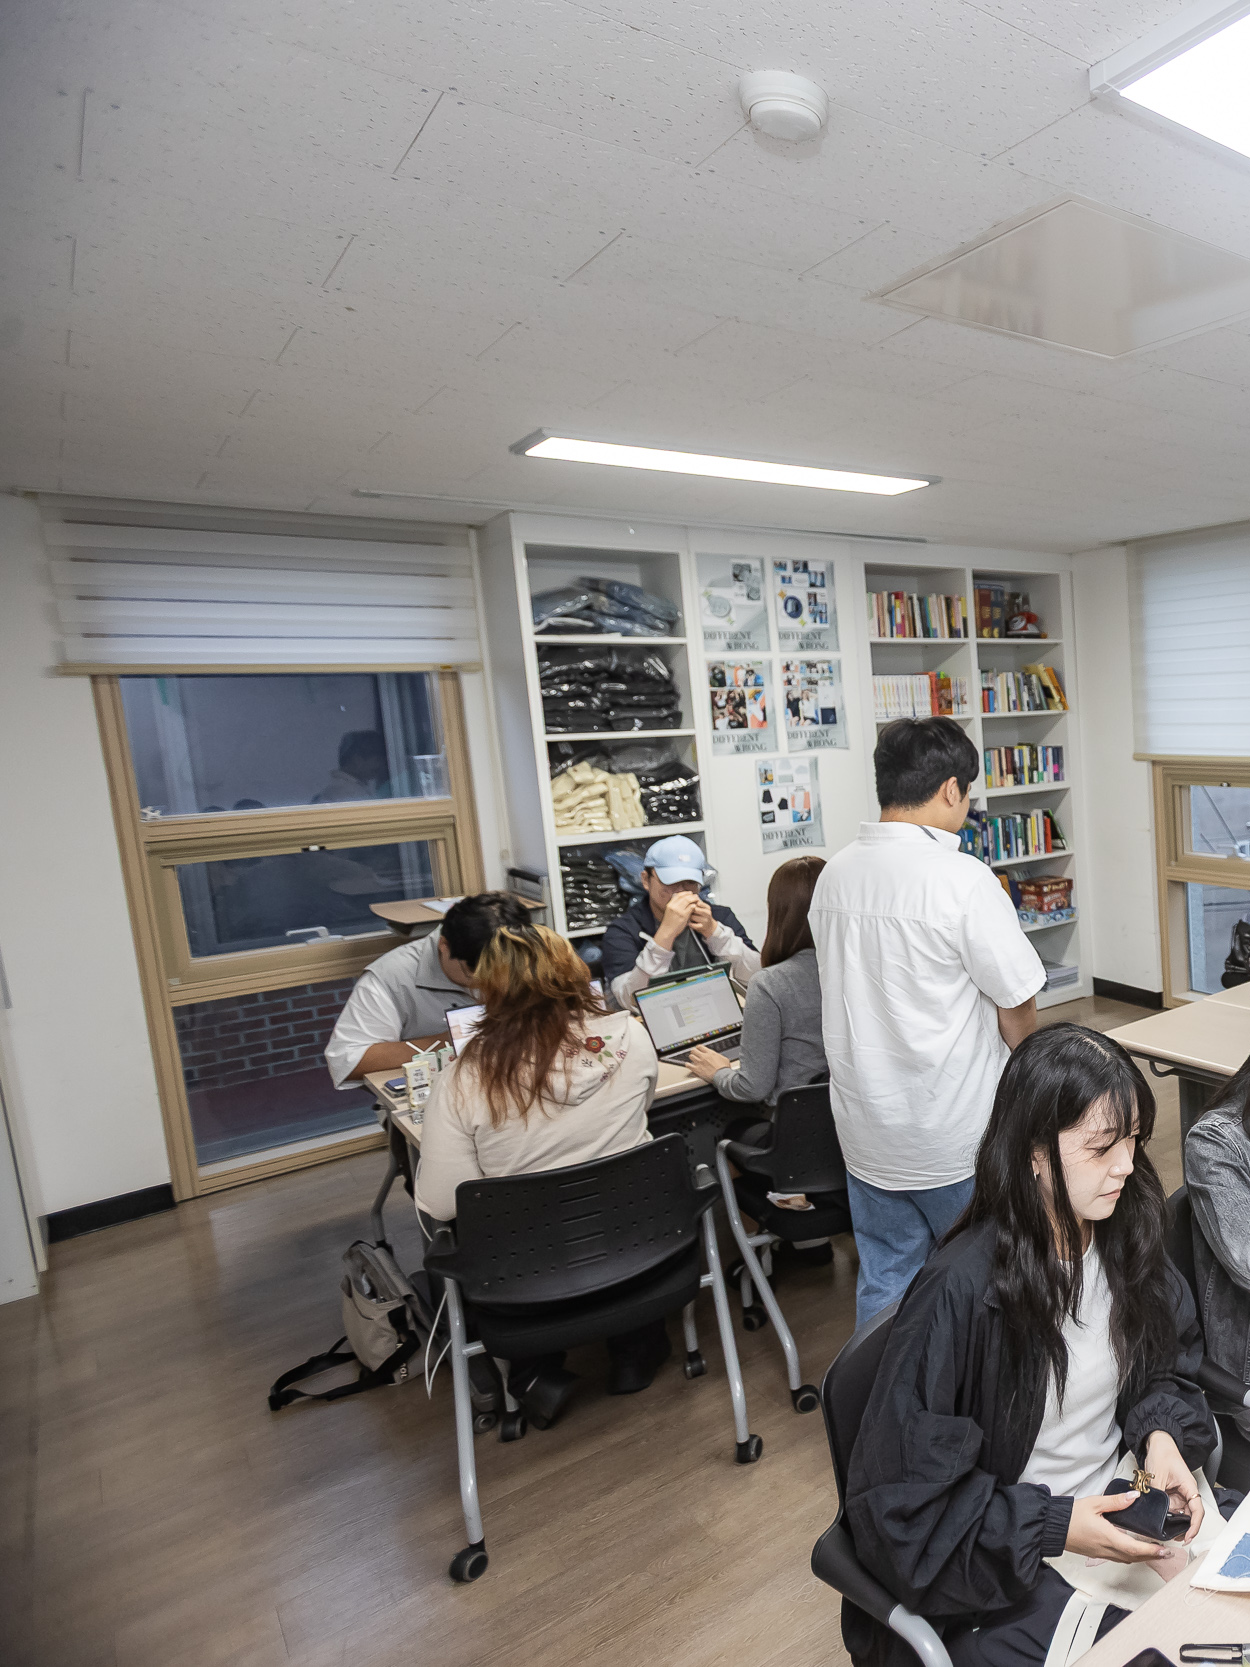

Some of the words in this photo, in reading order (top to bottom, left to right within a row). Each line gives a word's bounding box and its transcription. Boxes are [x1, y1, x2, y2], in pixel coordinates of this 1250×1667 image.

[704, 631, 752, 640] DIFFERENT
[779, 631, 822, 640] DIFFERENT
[726, 641, 760, 650] WRONG
[798, 641, 830, 650] WRONG
[712, 733, 760, 744] DIFFERENT
[786, 730, 830, 740] DIFFERENT
[733, 743, 767, 752] WRONG
[806, 738, 837, 749] WRONG
[762, 828, 806, 841] DIFFERENT
[782, 837, 813, 847] WRONG
